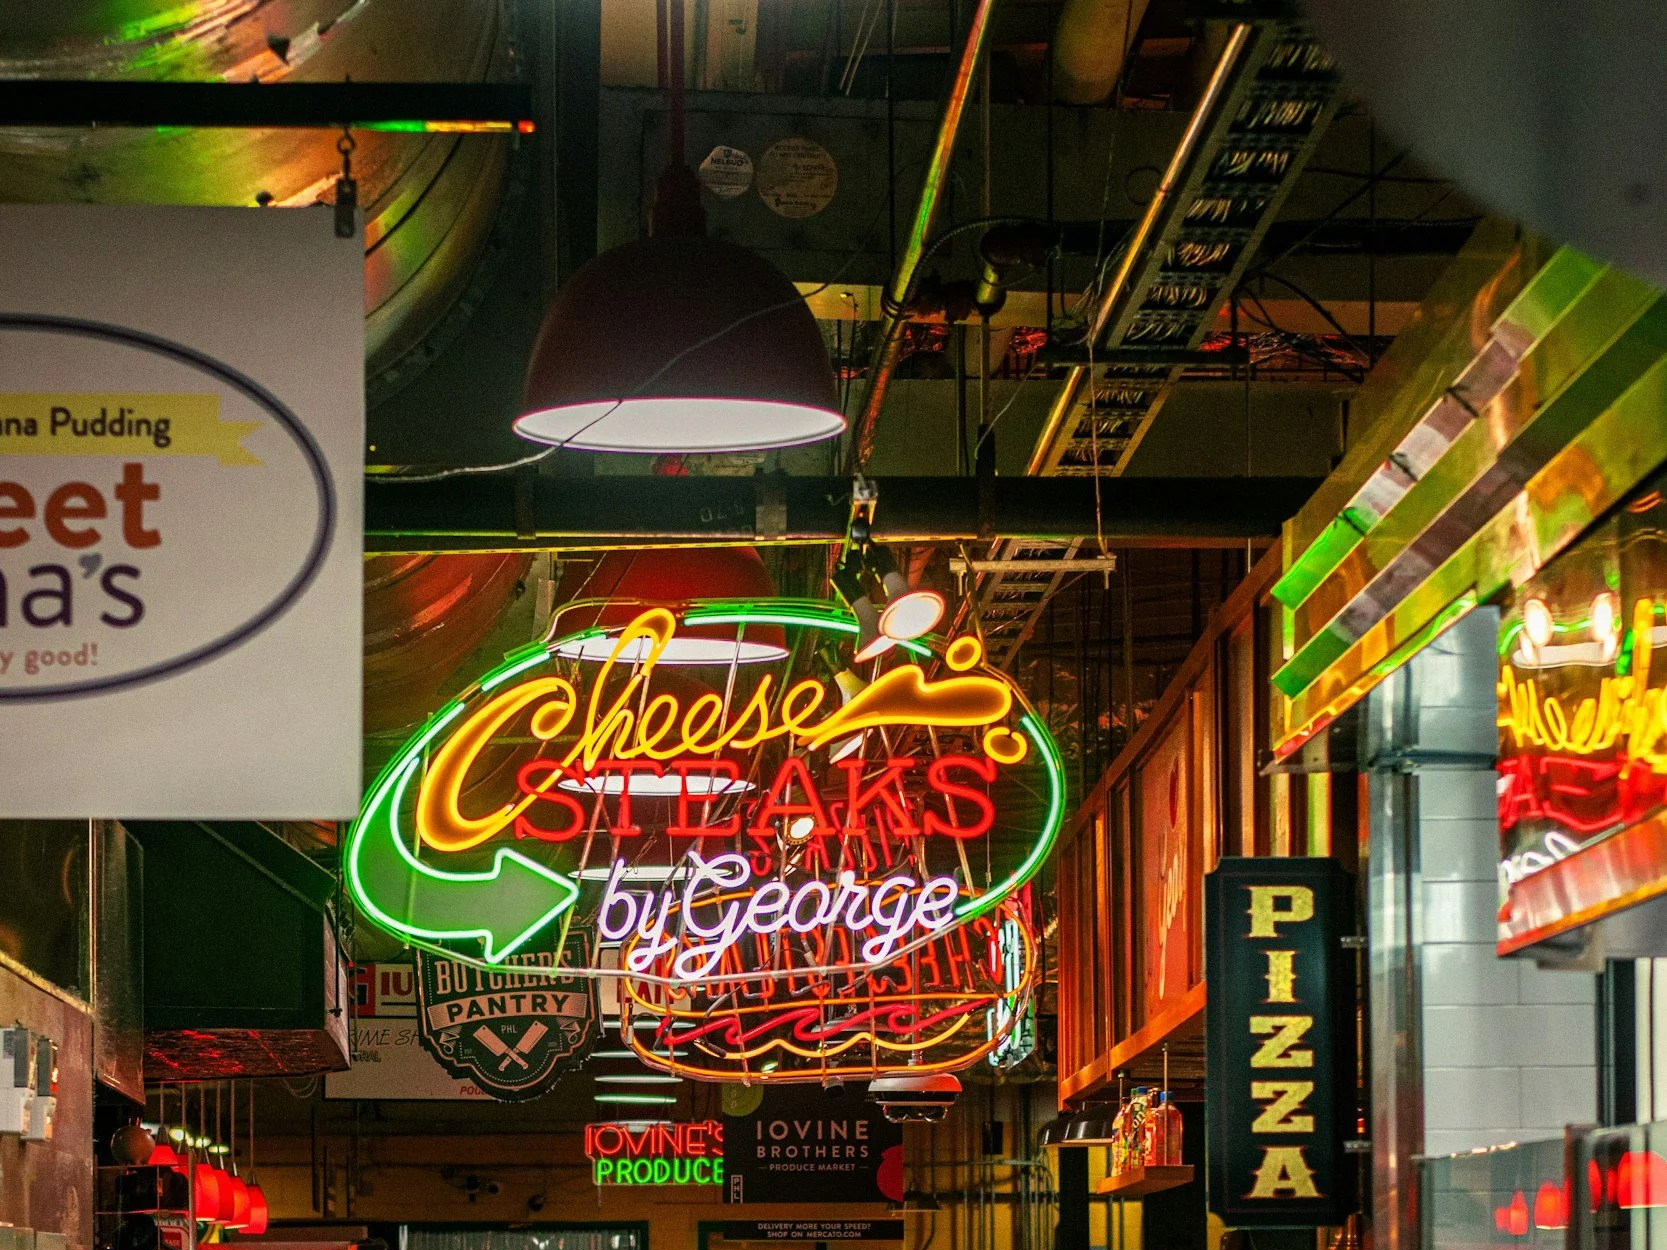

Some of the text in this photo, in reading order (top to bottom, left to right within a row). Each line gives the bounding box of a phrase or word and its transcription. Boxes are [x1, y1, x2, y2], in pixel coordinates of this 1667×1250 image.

[0, 406, 172, 448] na Pudding
[0, 553, 146, 629] a's
[24, 641, 99, 676] good!
[415, 608, 838, 852] Cheese
[513, 754, 998, 842] STEAKS
[598, 851, 960, 982] by George
[446, 994, 570, 1023] PANTRY
[501, 1024, 518, 1034] PHL
[1242, 884, 1325, 1199] PIZZA
[756, 1119, 869, 1140] IOVINE
[756, 1145, 869, 1158] BROTHERS
[769, 1163, 856, 1172] PRODUCE MARKET
[596, 1157, 724, 1184] PRODUCE
